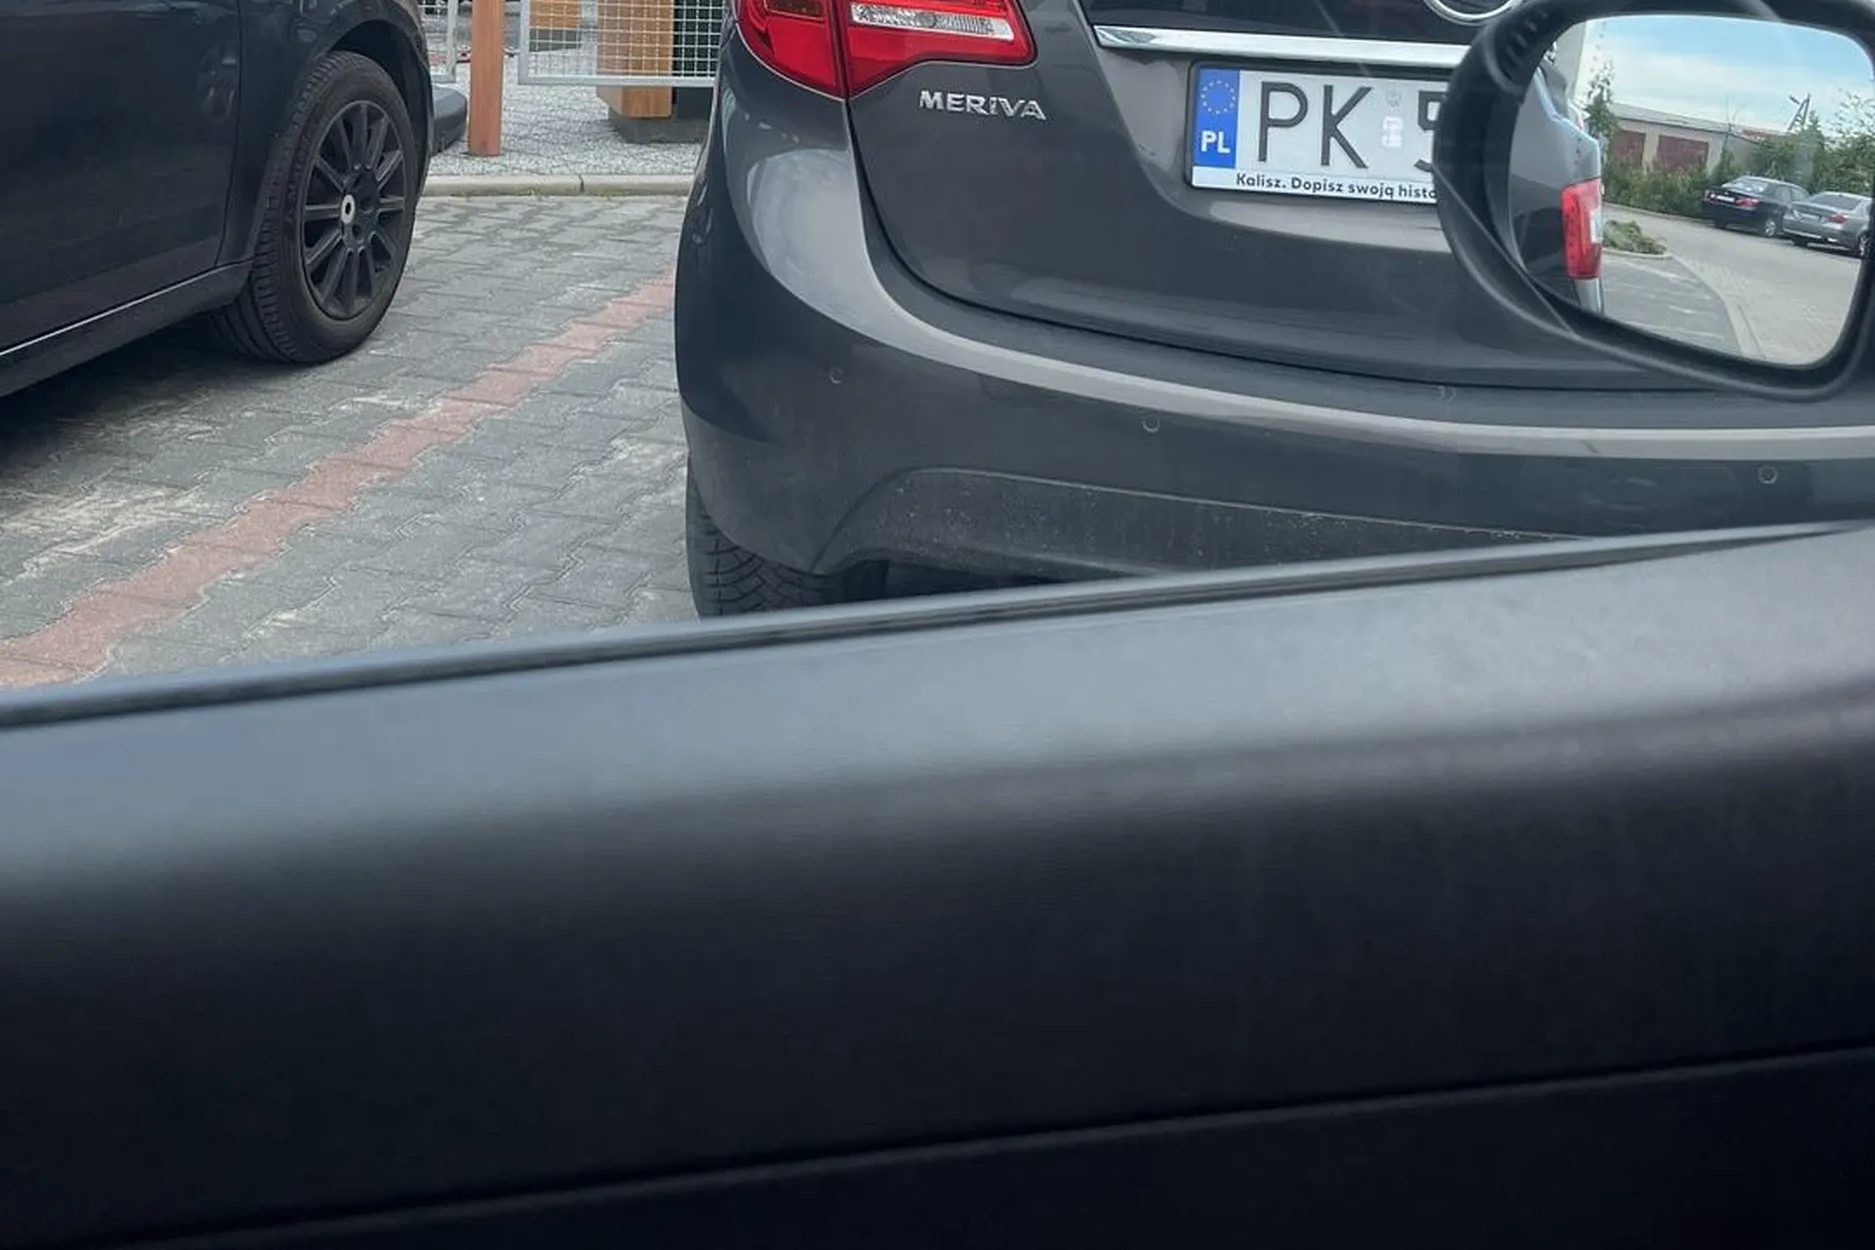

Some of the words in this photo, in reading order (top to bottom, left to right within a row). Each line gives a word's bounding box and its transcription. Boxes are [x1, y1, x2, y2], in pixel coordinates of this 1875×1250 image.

[919, 90, 1047, 121] MERIVA
[1257, 81, 1373, 169] PK
[1201, 130, 1231, 154] PL
[1235, 172, 1287, 189] Kalisz.
[1291, 177, 1344, 193] Dopisz
[1349, 183, 1394, 200] swoją
